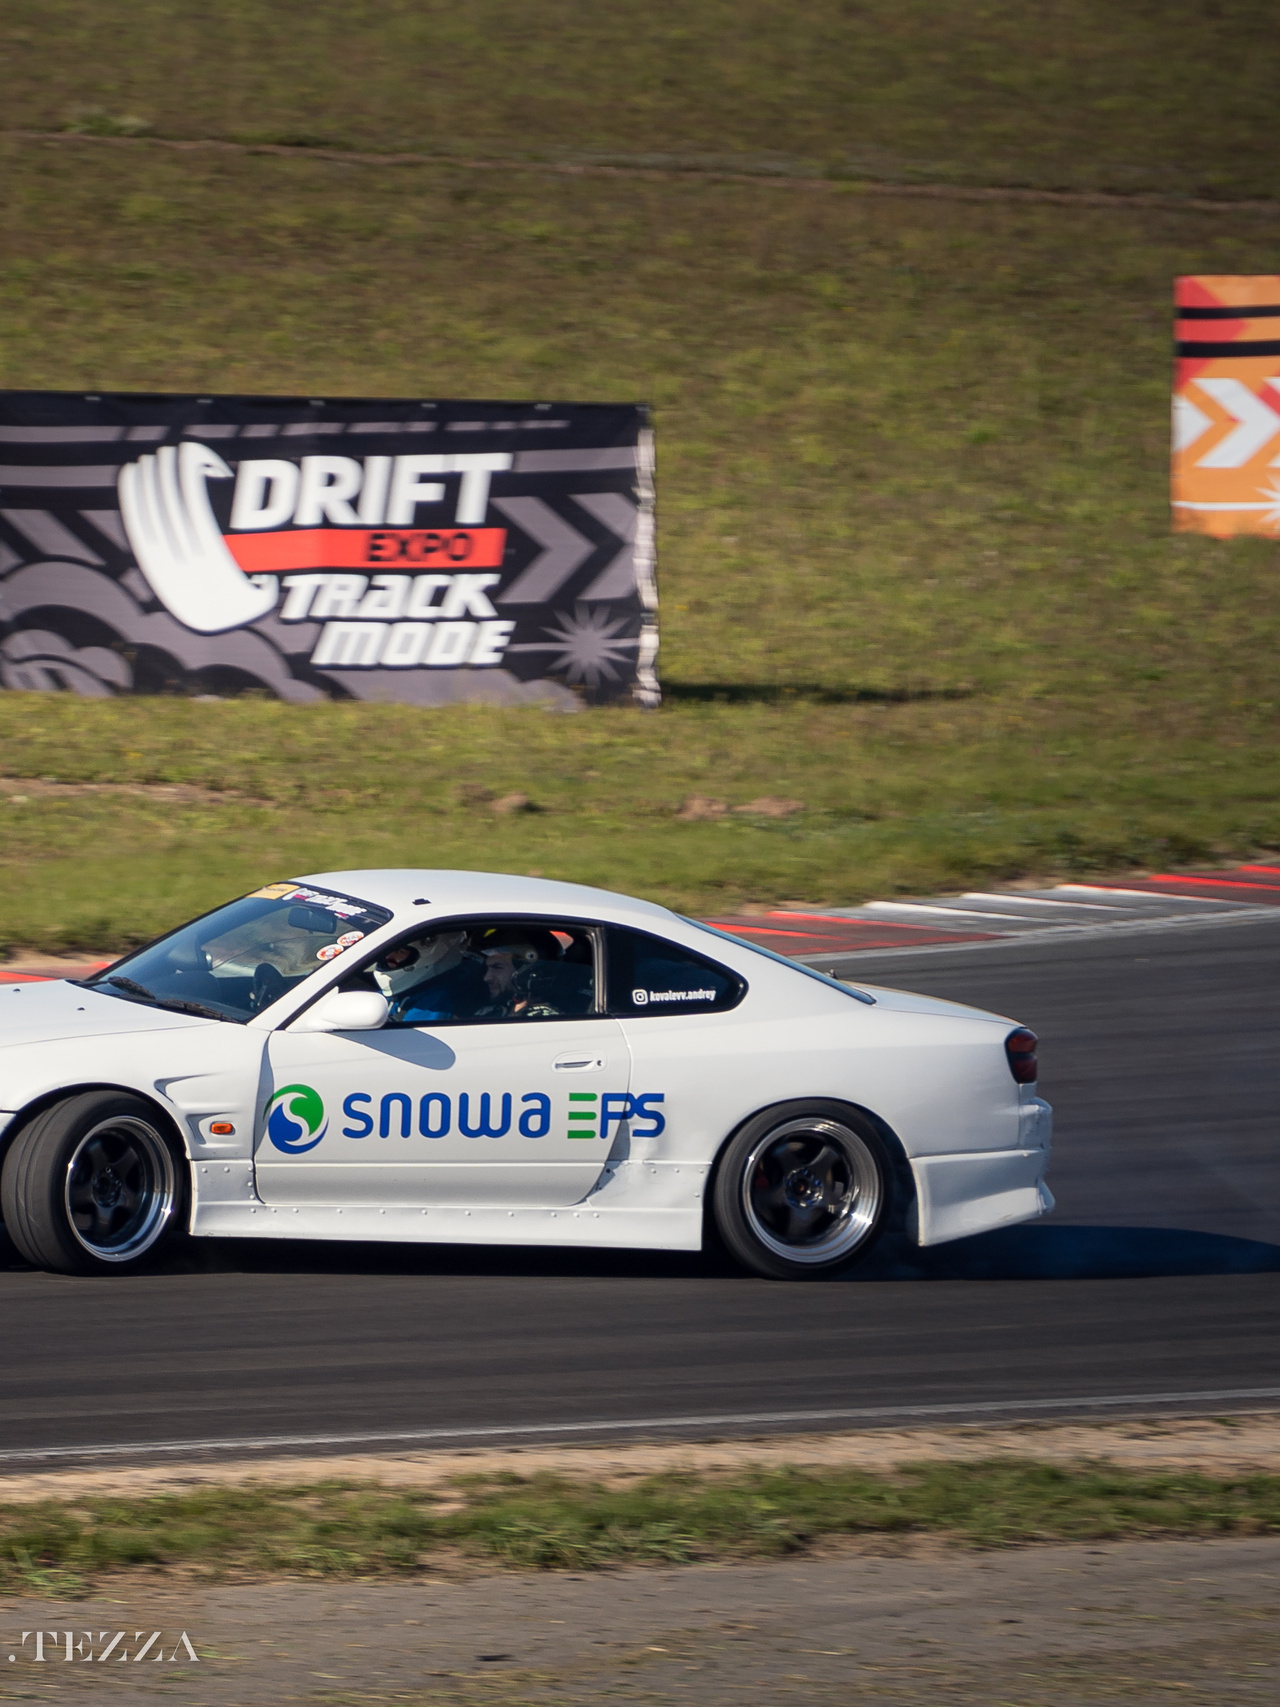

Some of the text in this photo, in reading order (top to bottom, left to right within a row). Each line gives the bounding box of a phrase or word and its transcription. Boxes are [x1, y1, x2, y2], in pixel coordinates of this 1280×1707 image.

[230, 453, 513, 530] DRIFT
[366, 532, 474, 562] EXPO
[567, 1092, 666, 1139] EPS
